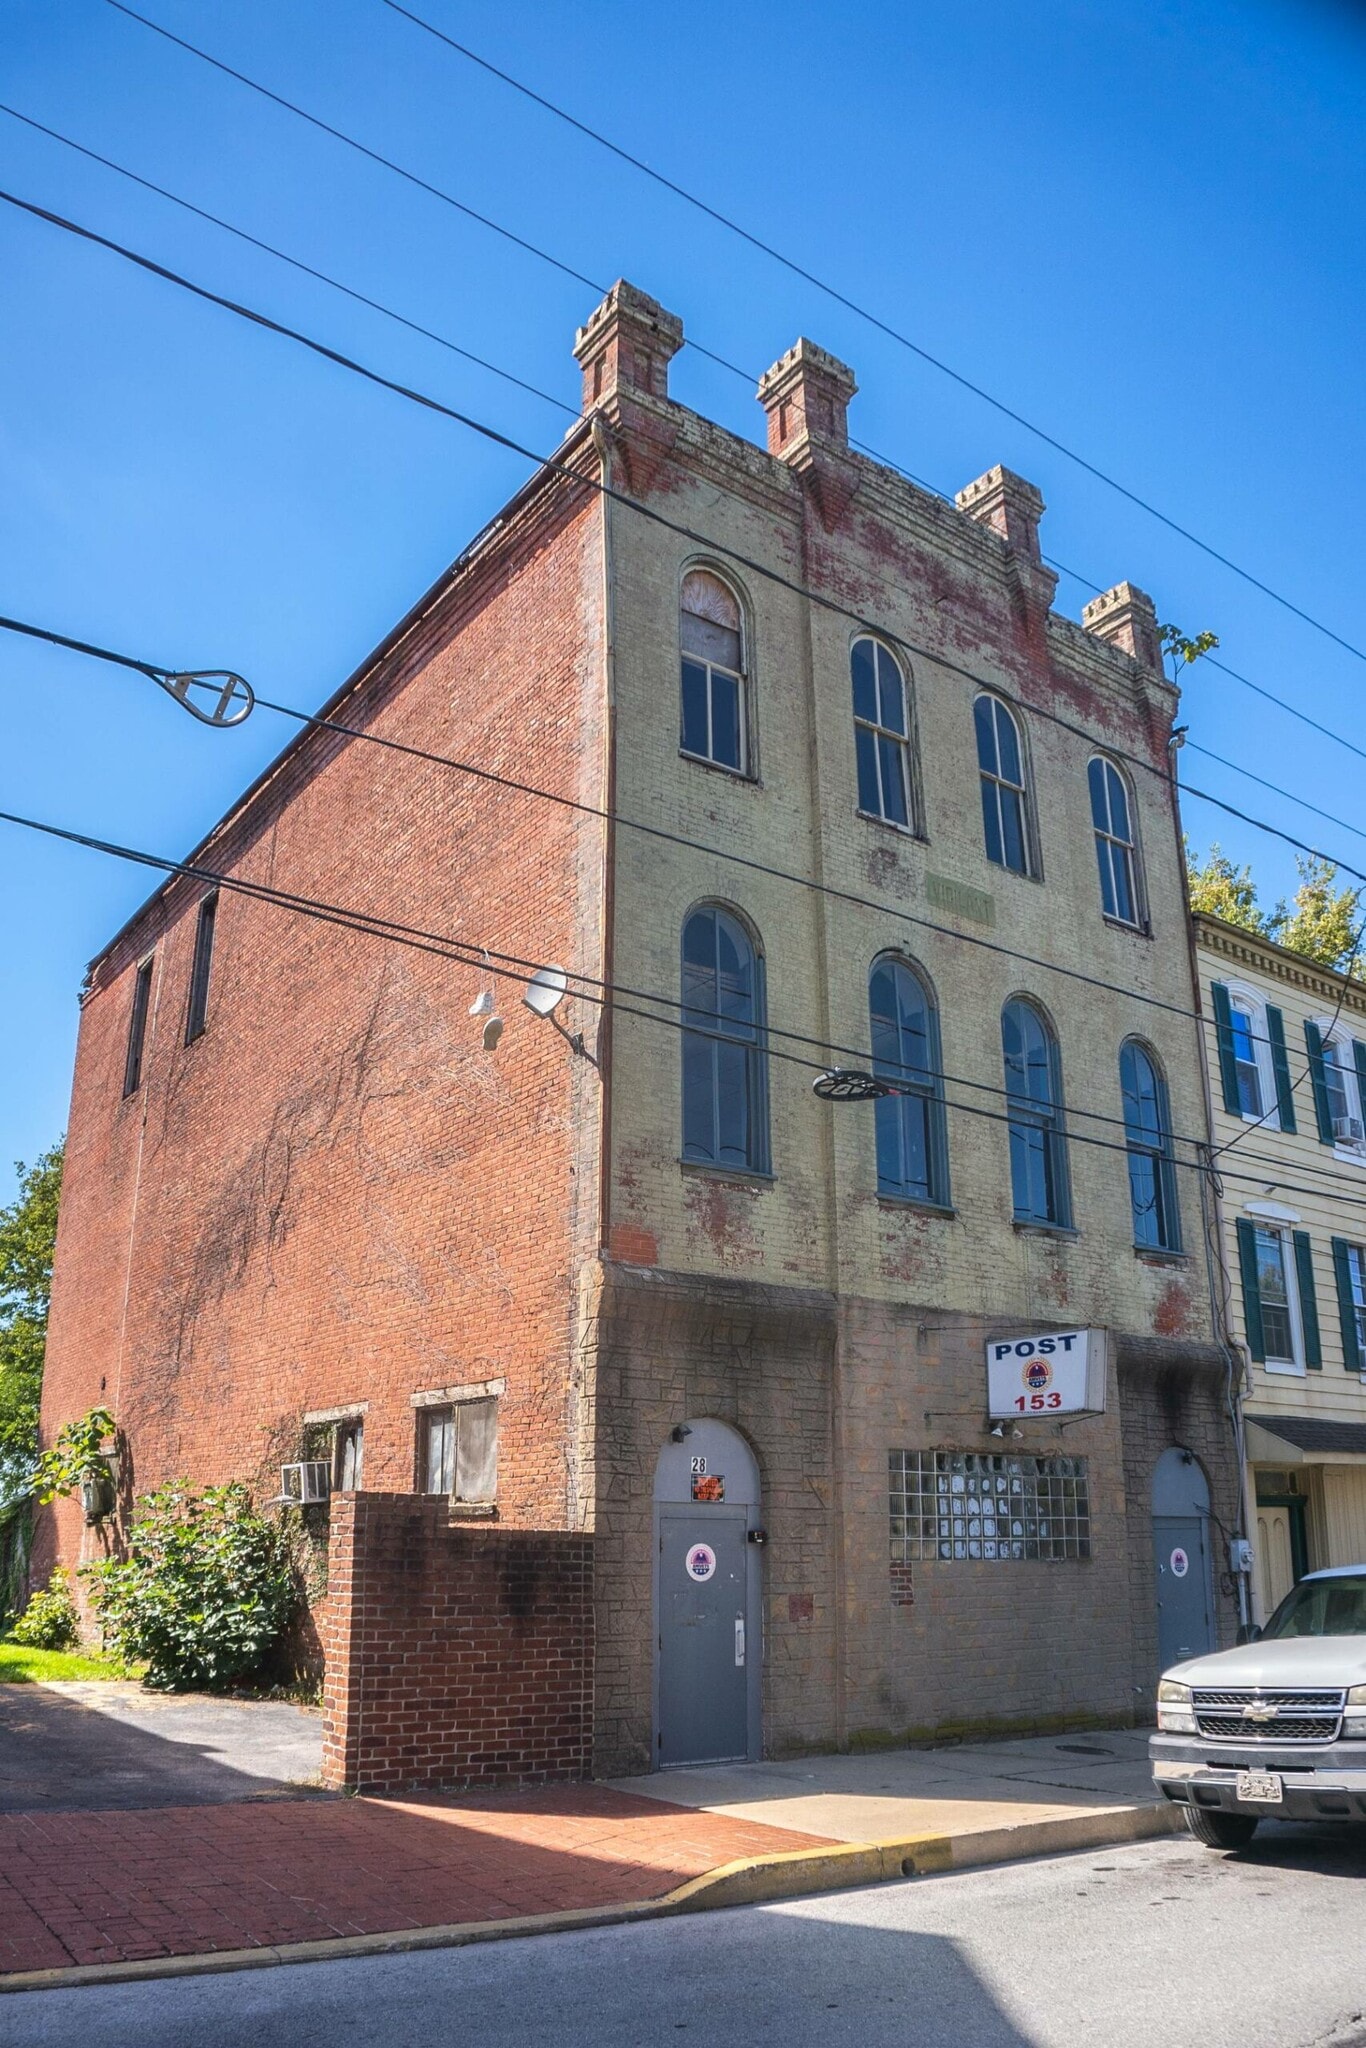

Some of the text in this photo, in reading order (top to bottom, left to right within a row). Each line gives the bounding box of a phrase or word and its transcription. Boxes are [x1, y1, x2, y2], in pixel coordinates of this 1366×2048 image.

[995, 1334, 1077, 1360] POST
[1014, 1392, 1062, 1411] 153
[692, 1457, 706, 1473] 28
